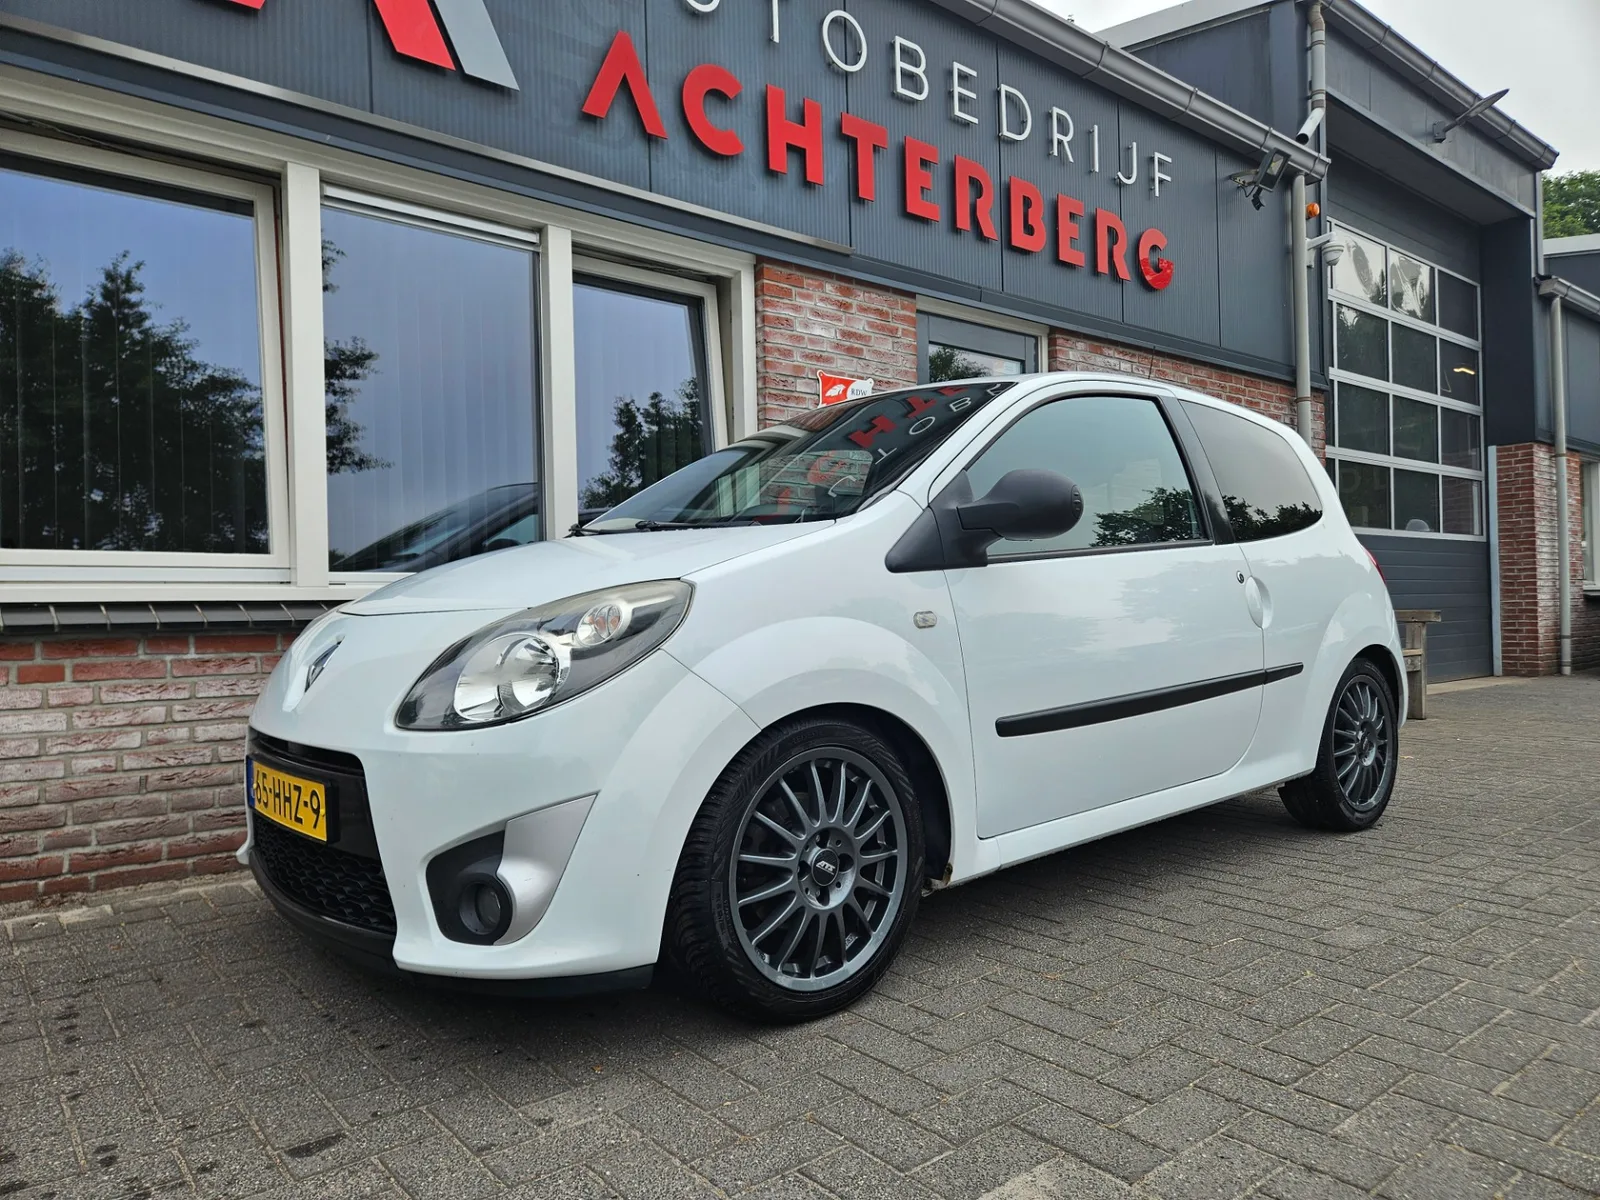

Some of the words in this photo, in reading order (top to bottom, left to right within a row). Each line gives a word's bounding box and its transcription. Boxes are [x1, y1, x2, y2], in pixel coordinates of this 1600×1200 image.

[581, 29, 1175, 290] ACHTERBERG
[850, 388, 868, 396] RDW
[254, 769, 321, 830] 65-HHZ-9
